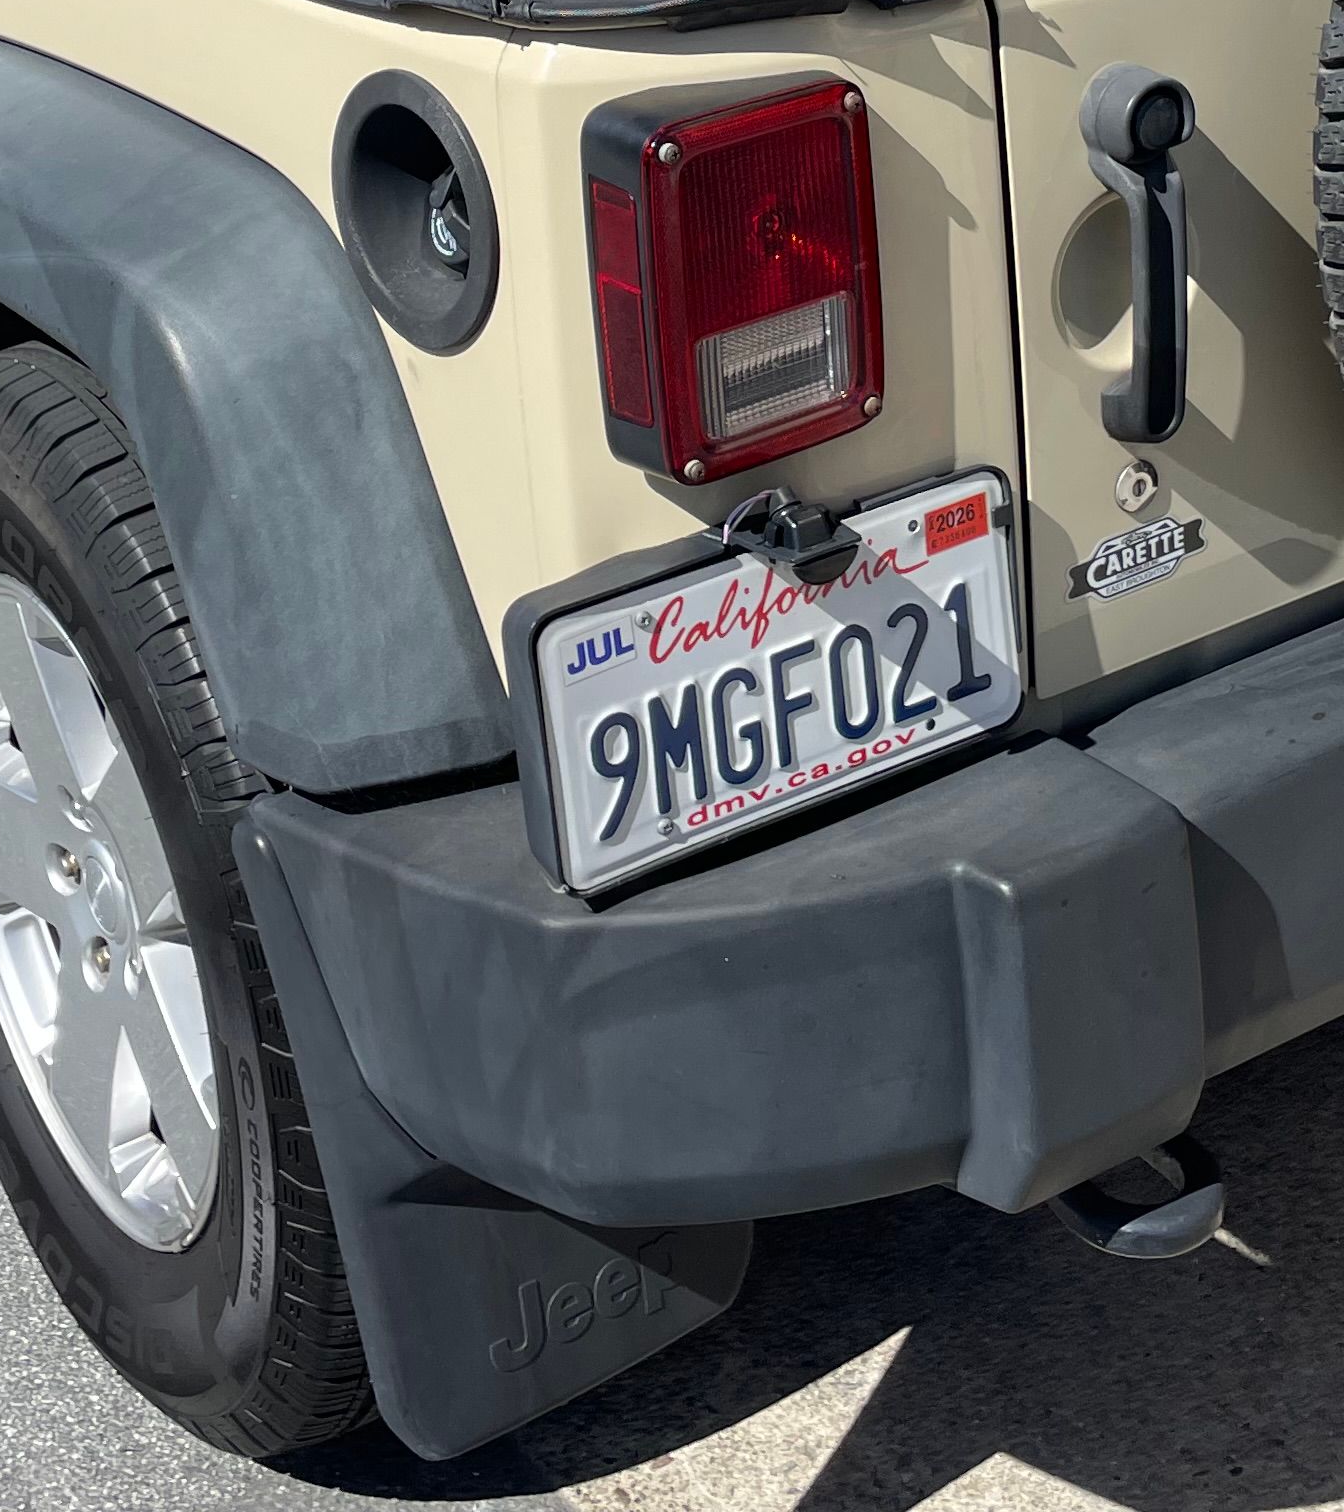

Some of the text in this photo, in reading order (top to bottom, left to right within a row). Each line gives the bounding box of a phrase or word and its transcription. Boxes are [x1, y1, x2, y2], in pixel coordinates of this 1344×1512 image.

[936, 503, 976, 534] 2026
[1086, 526, 1186, 590] CARETTE
[1105, 581, 1126, 596] EAST
[567, 626, 635, 676] JUL
[590, 582, 993, 842] 9MGF021
[687, 727, 916, 829] dmv.ca.gov
[489, 1231, 680, 1374] Jeep
